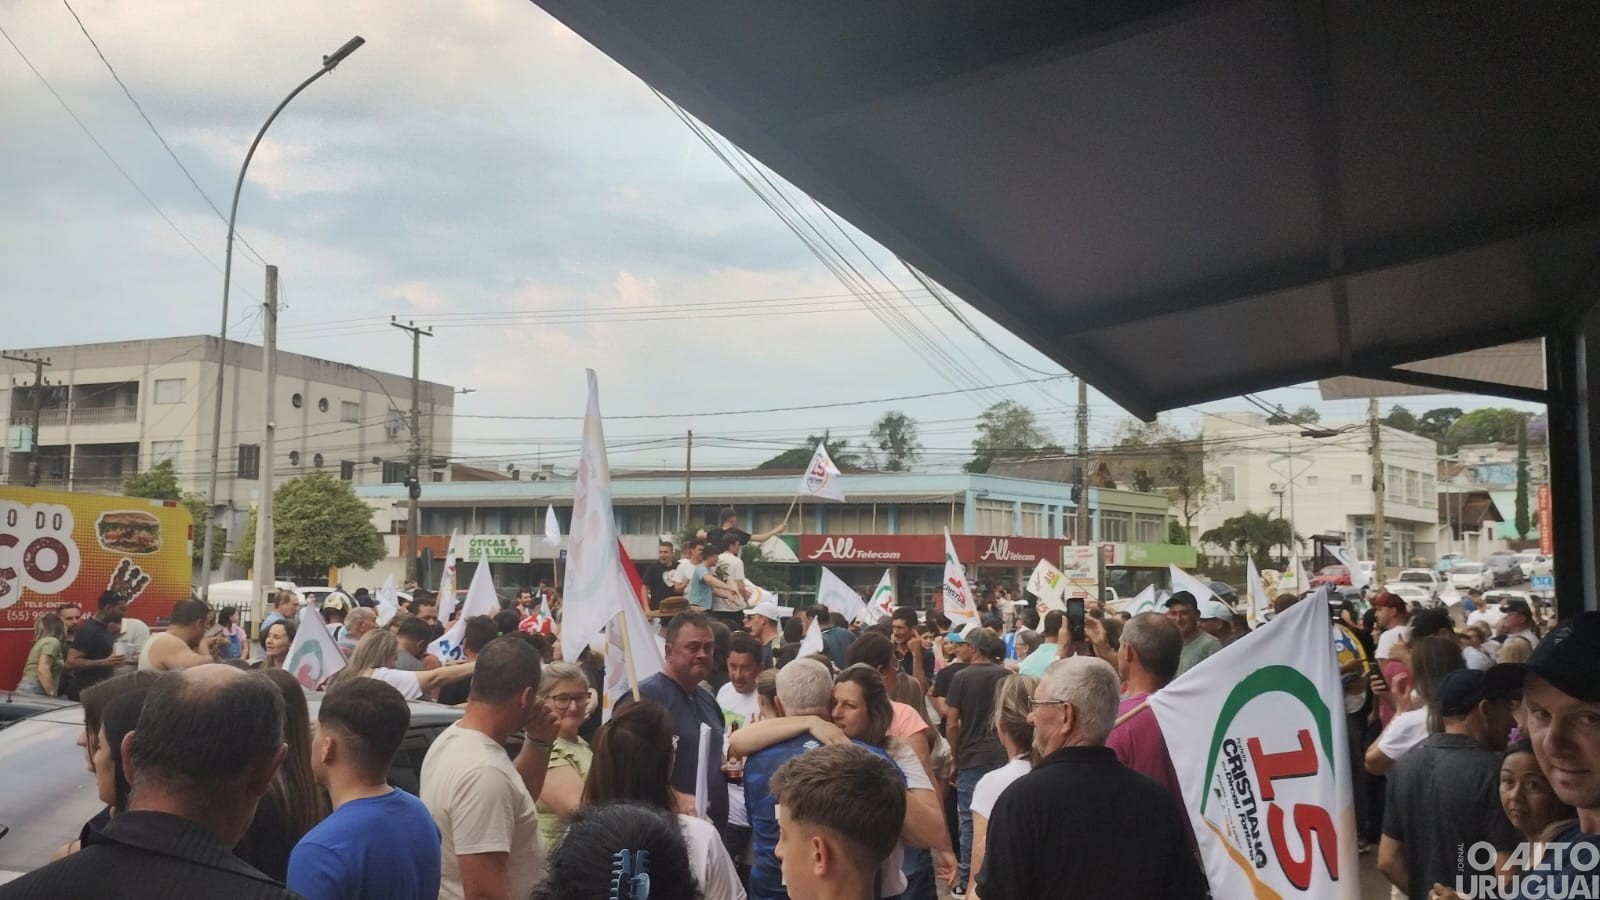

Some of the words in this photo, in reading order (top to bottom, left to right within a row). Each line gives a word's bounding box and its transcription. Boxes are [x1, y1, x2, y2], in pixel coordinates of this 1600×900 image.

[36, 511, 62, 531] DO
[808, 537, 857, 559] All
[856, 550, 901, 559] Telecom
[980, 538, 1010, 561] All
[1222, 738, 1267, 869] CRISTIANO
[1247, 728, 1339, 892] 15
[1238, 812, 1254, 861] Fontana
